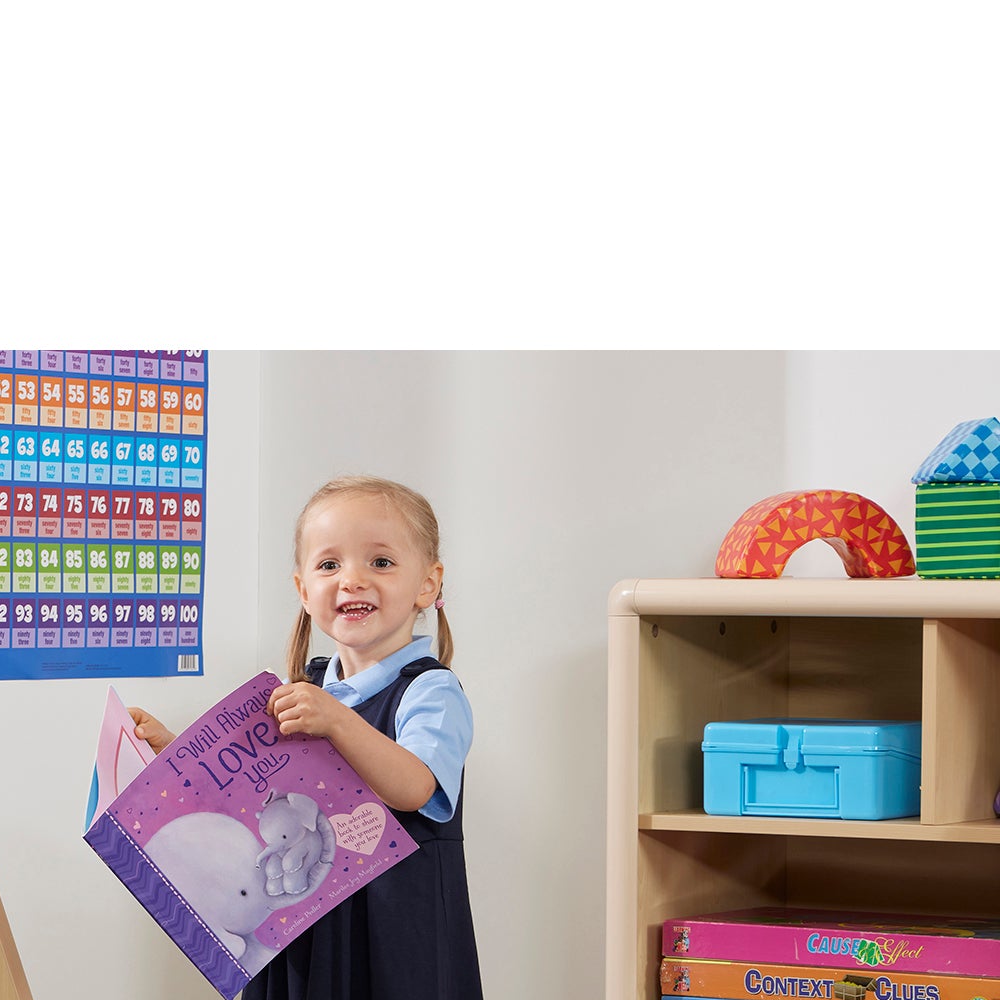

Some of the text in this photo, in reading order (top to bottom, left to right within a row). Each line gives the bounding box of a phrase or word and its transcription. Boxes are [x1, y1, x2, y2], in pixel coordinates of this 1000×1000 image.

[19, 382, 35, 399] 53
[44, 383, 60, 401] 54
[69, 385, 84, 403] 55
[93, 387, 109, 404] 56
[118, 388, 132, 406] 57
[141, 390, 155, 407] 58
[164, 392, 178, 408] 59
[185, 393, 201, 410] 60
[17, 438, 34, 455] 63
[42, 439, 59, 456] 64
[68, 440, 83, 458] 65
[92, 442, 108, 458] 66
[116, 443, 130, 459] 67
[139, 444, 154, 461] 68
[162, 446, 177, 462] 69
[185, 447, 200, 463] 70
[17, 493, 33, 511] 73
[43, 495, 57, 512] 74
[67, 496, 82, 513] 75
[91, 496, 106, 513] 76
[115, 498, 130, 513] 77
[139, 498, 153, 515] 78
[162, 499, 177, 515] 79
[184, 499, 200, 517] 80
[16, 549, 32, 567] 83
[41, 550, 58, 567] 84
[66, 550, 82, 568] 85
[90, 551, 106, 568] 86
[115, 551, 130, 568] 87
[139, 552, 154, 568] 88
[162, 552, 177, 569] 89
[184, 553, 199, 569] 90
[16, 605, 32, 622] 93
[41, 605, 58, 622] 94
[66, 605, 82, 622] 95
[91, 605, 107, 622] 96
[115, 605, 131, 622] 97
[139, 605, 154, 622] 98
[161, 605, 175, 621] 99
[180, 606, 197, 622] 100
[165, 688, 273, 777] I Will Always
[807, 932, 924, 966] CAUSE Effect
[744, 968, 834, 998] CONTEXT
